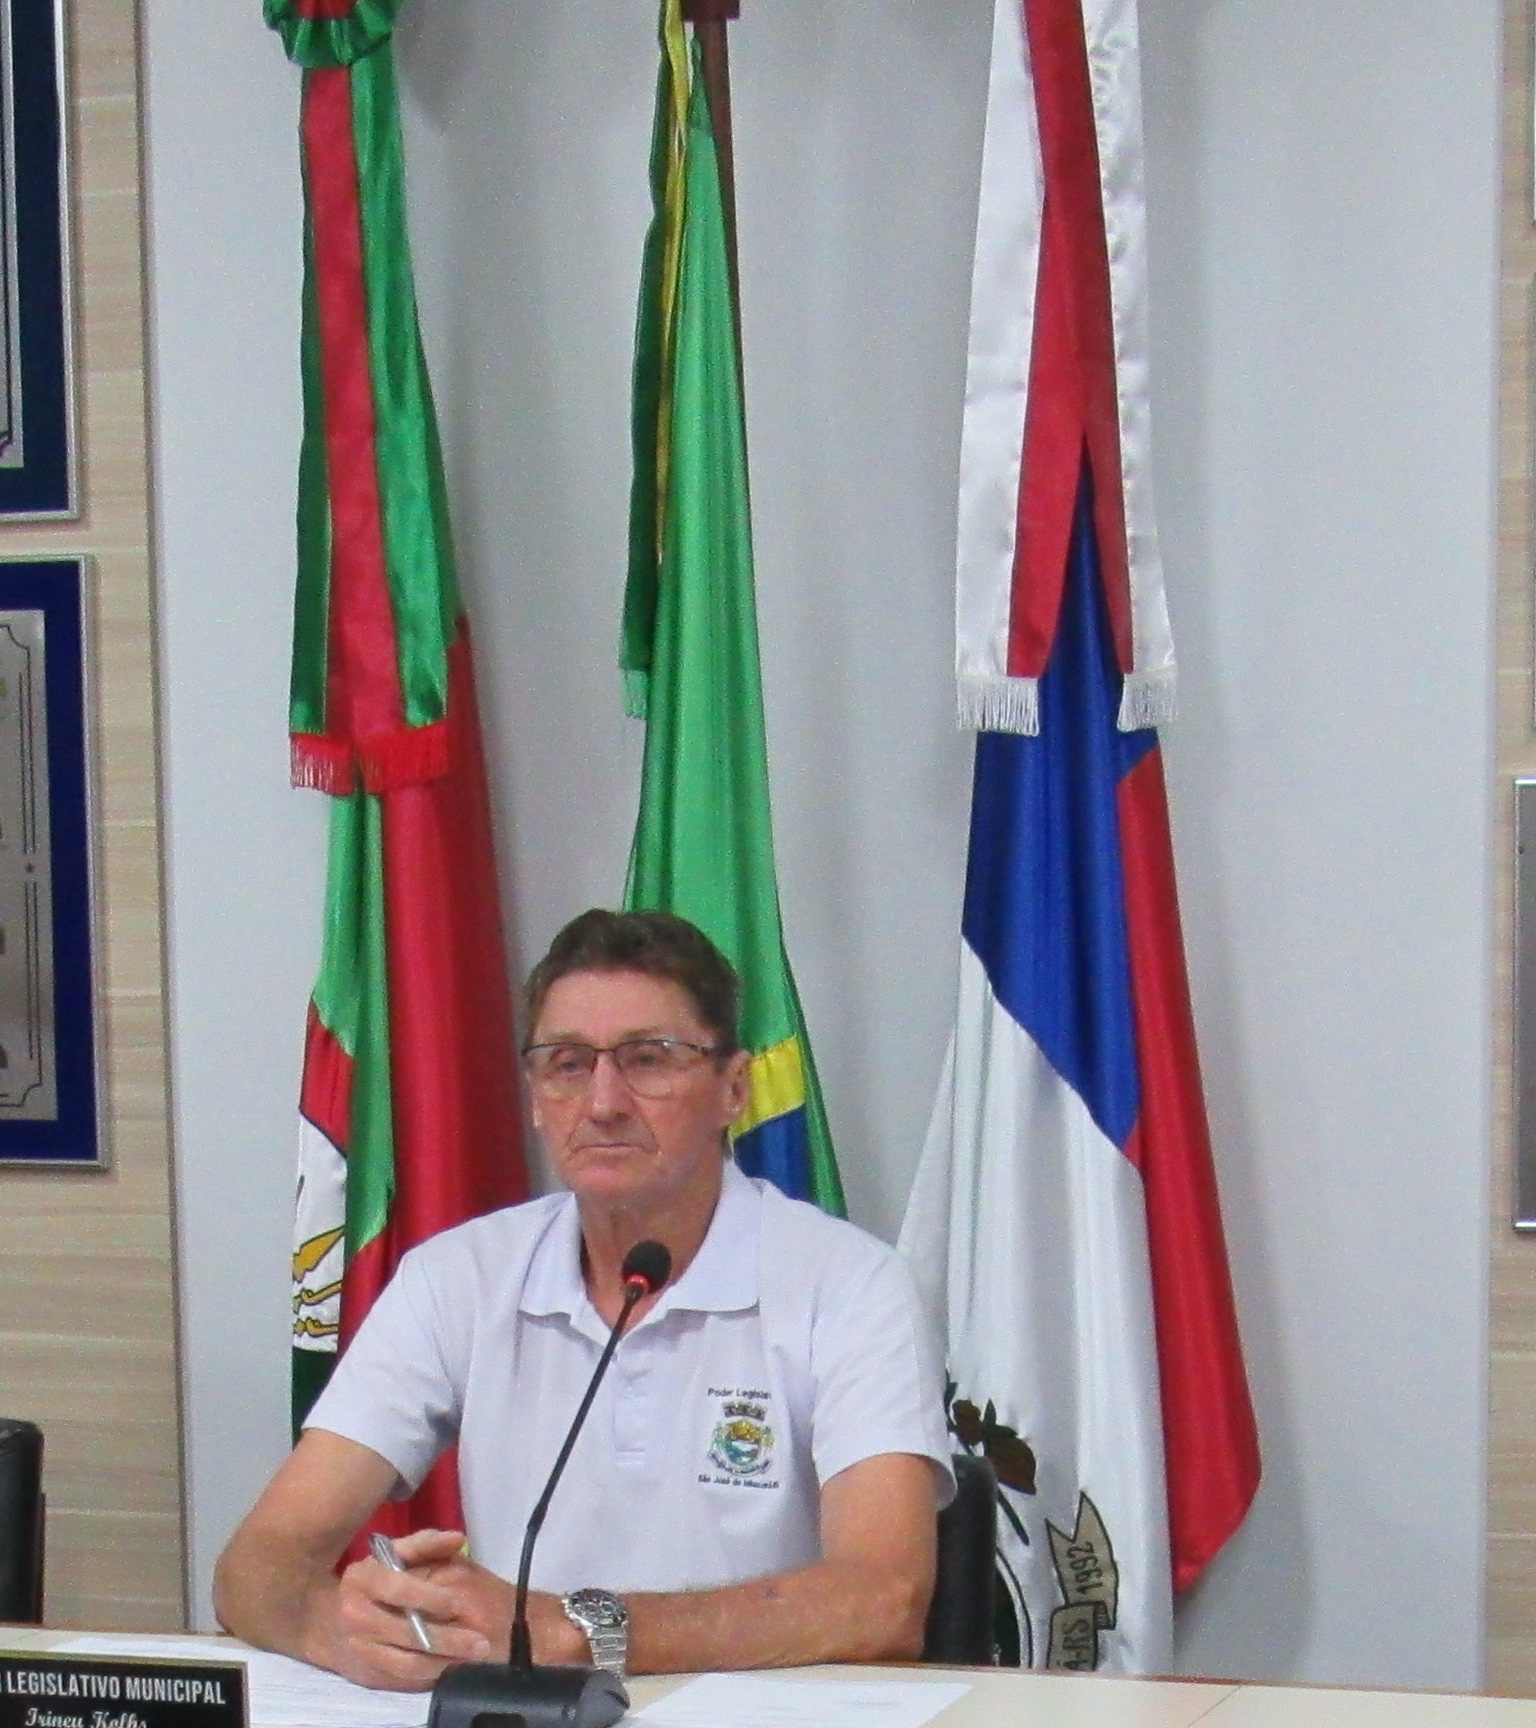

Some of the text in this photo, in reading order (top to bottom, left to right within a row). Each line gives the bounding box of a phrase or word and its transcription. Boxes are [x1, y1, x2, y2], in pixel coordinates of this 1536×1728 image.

[1066, 1540, 1104, 1595] 1992
[5, 1670, 121, 1701] LEGISLATIVO
[124, 1676, 227, 1706] MUNICIPAL
